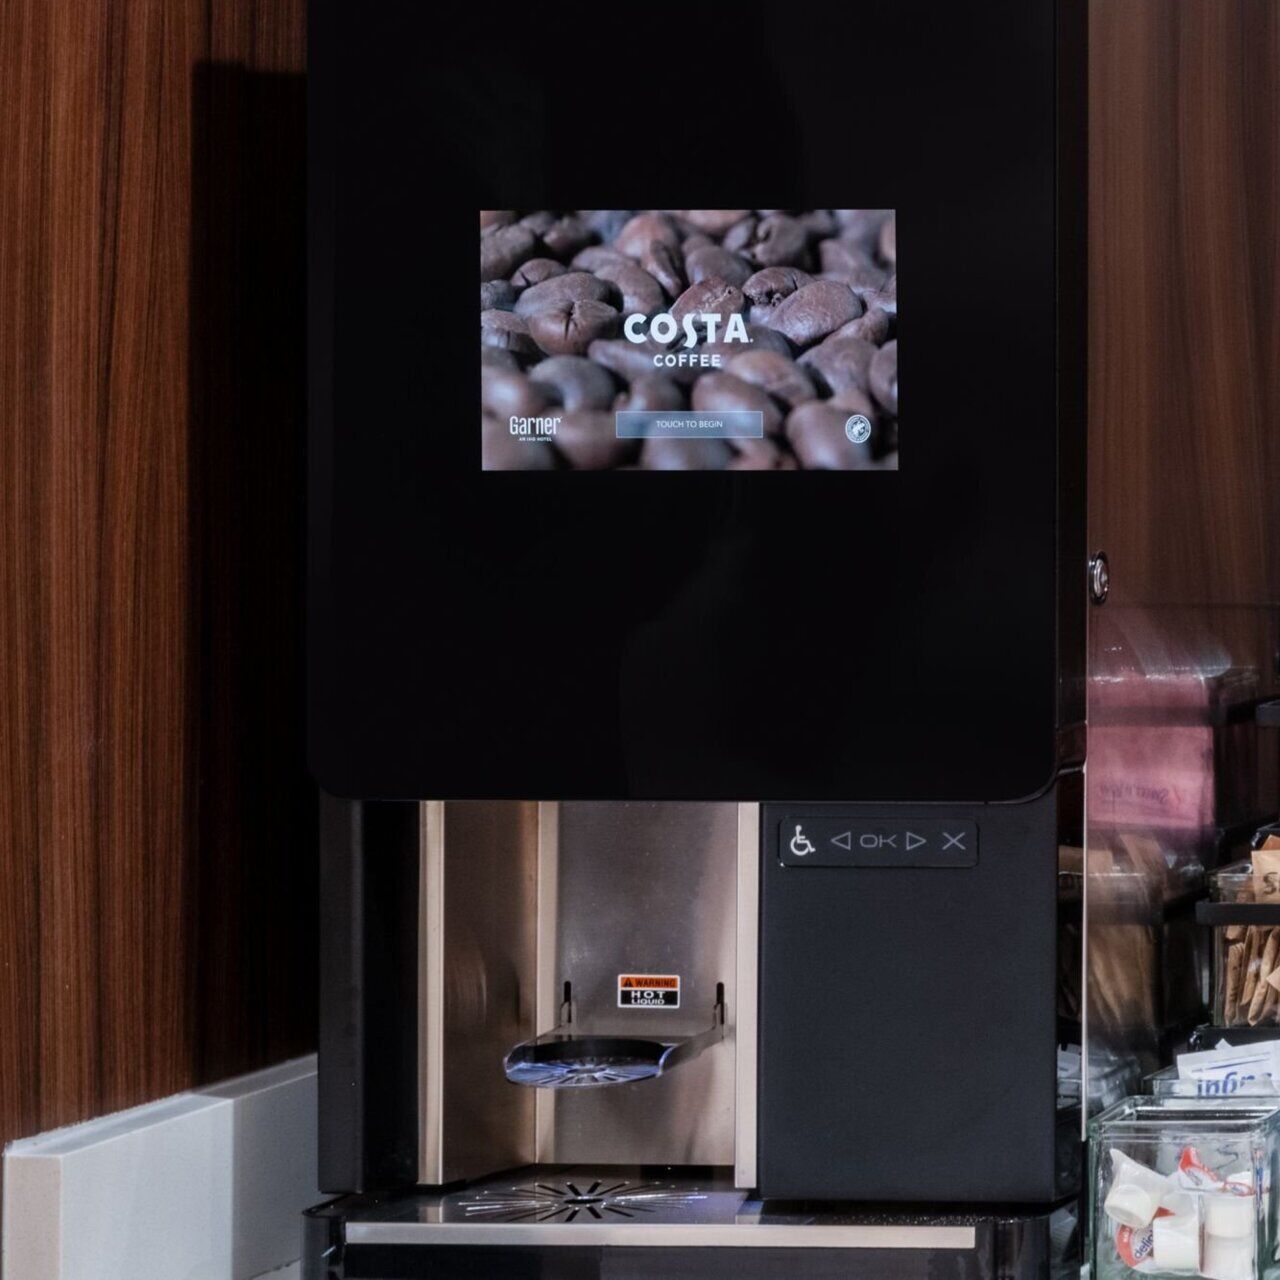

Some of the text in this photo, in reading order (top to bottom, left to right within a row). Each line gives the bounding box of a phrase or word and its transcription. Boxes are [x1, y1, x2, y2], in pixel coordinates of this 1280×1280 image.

[623, 313, 749, 348] COSTA
[653, 354, 722, 368] COFFEE
[509, 415, 562, 435] Garner
[656, 419, 723, 429] TOUCH TO BEGIN
[859, 834, 897, 848] OK
[636, 977, 676, 988] WARNING
[631, 990, 665, 999] HOT
